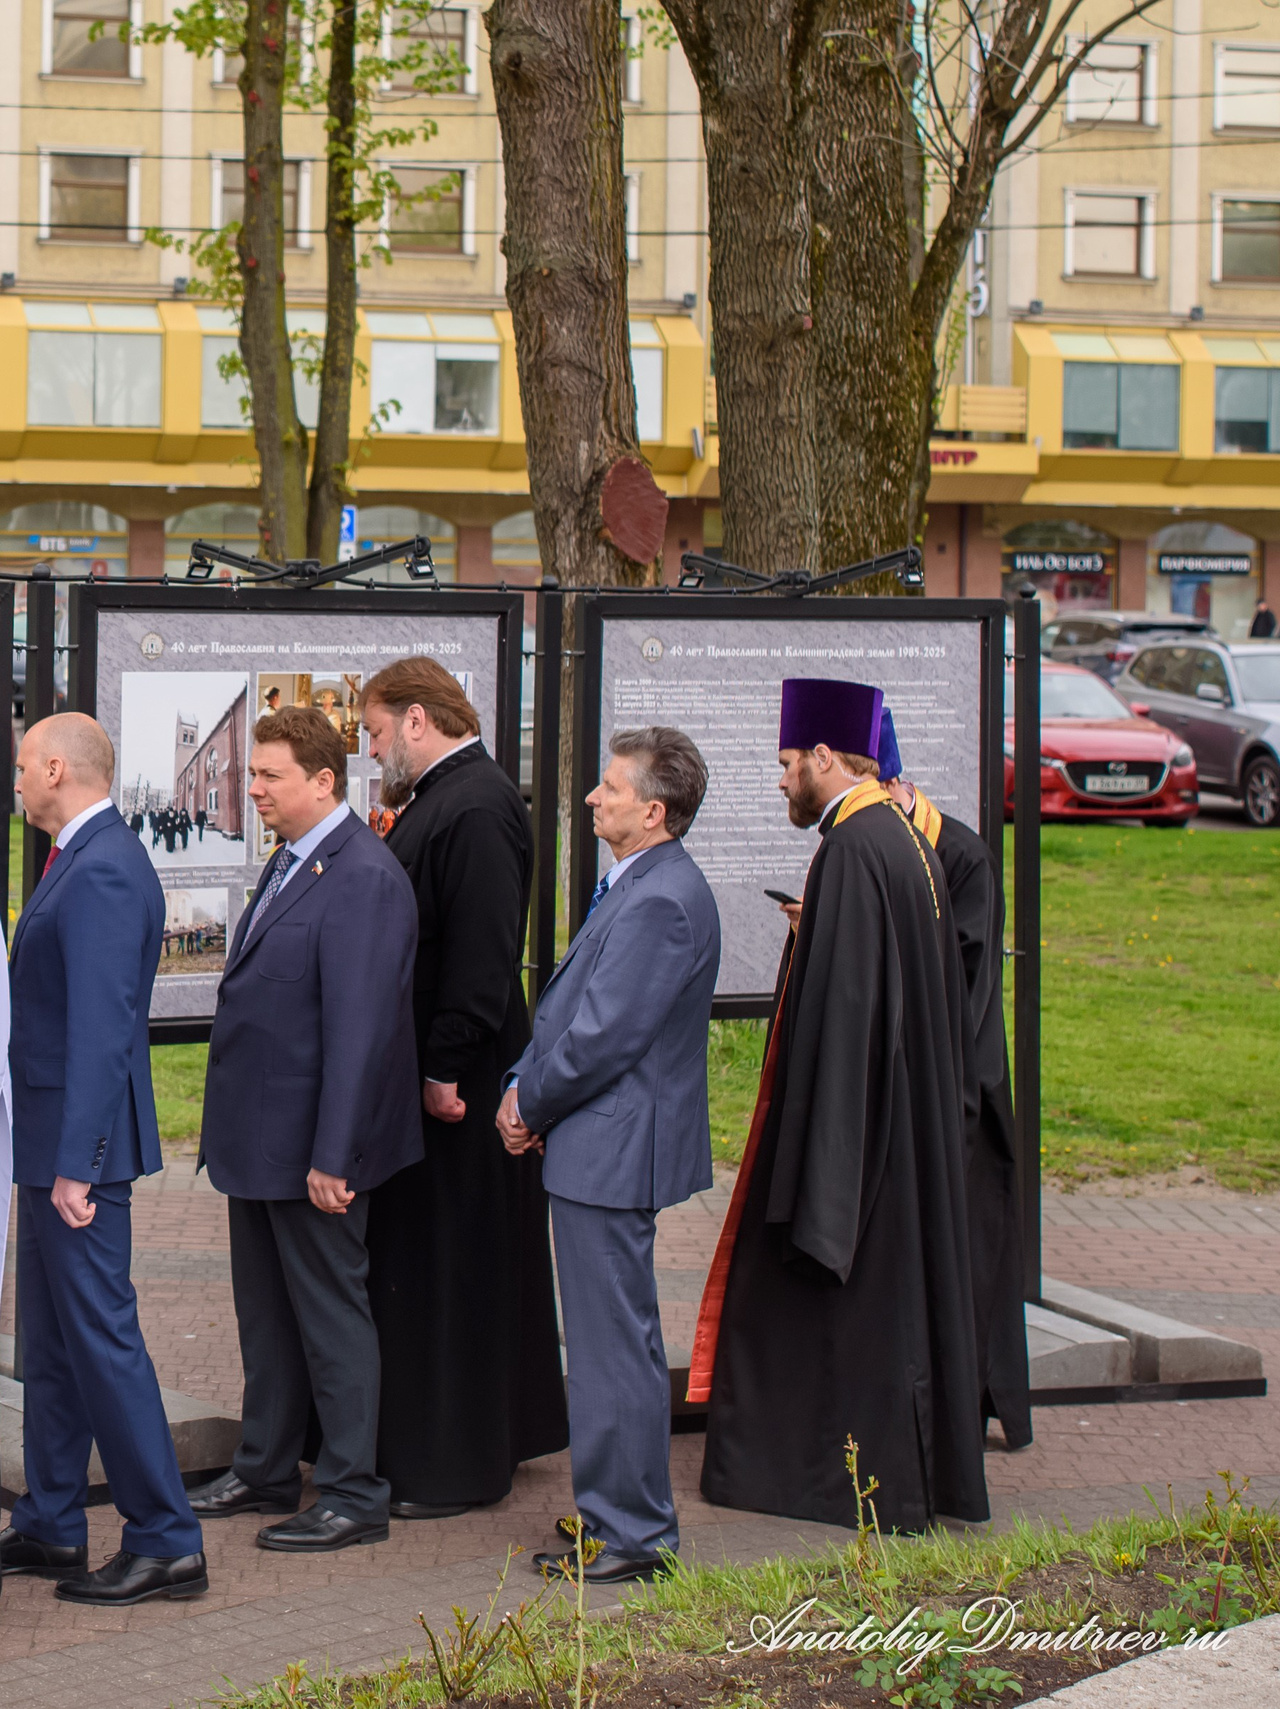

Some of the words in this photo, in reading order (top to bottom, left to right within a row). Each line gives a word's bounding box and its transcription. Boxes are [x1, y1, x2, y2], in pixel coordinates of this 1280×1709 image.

[40, 537, 67, 552] ВТБ
[1161, 556, 1251, 571] ПАРФЮМЕРИЯ
[170, 642, 184, 653] 40
[188, 644, 207, 653] лет
[210, 642, 275, 656] Православия
[278, 644, 290, 653] на
[294, 642, 377, 656] Калининградской
[379, 645, 409, 654] земле
[412, 643, 462, 655] 1985-2025
[670, 645, 683, 657] 40
[686, 648, 704, 657] лет
[707, 645, 767, 659] Православия
[771, 648, 781, 657] на
[785, 646, 864, 659] Калининградской
[867, 649, 895, 658] земле
[898, 646, 946, 658] 1985-2025
